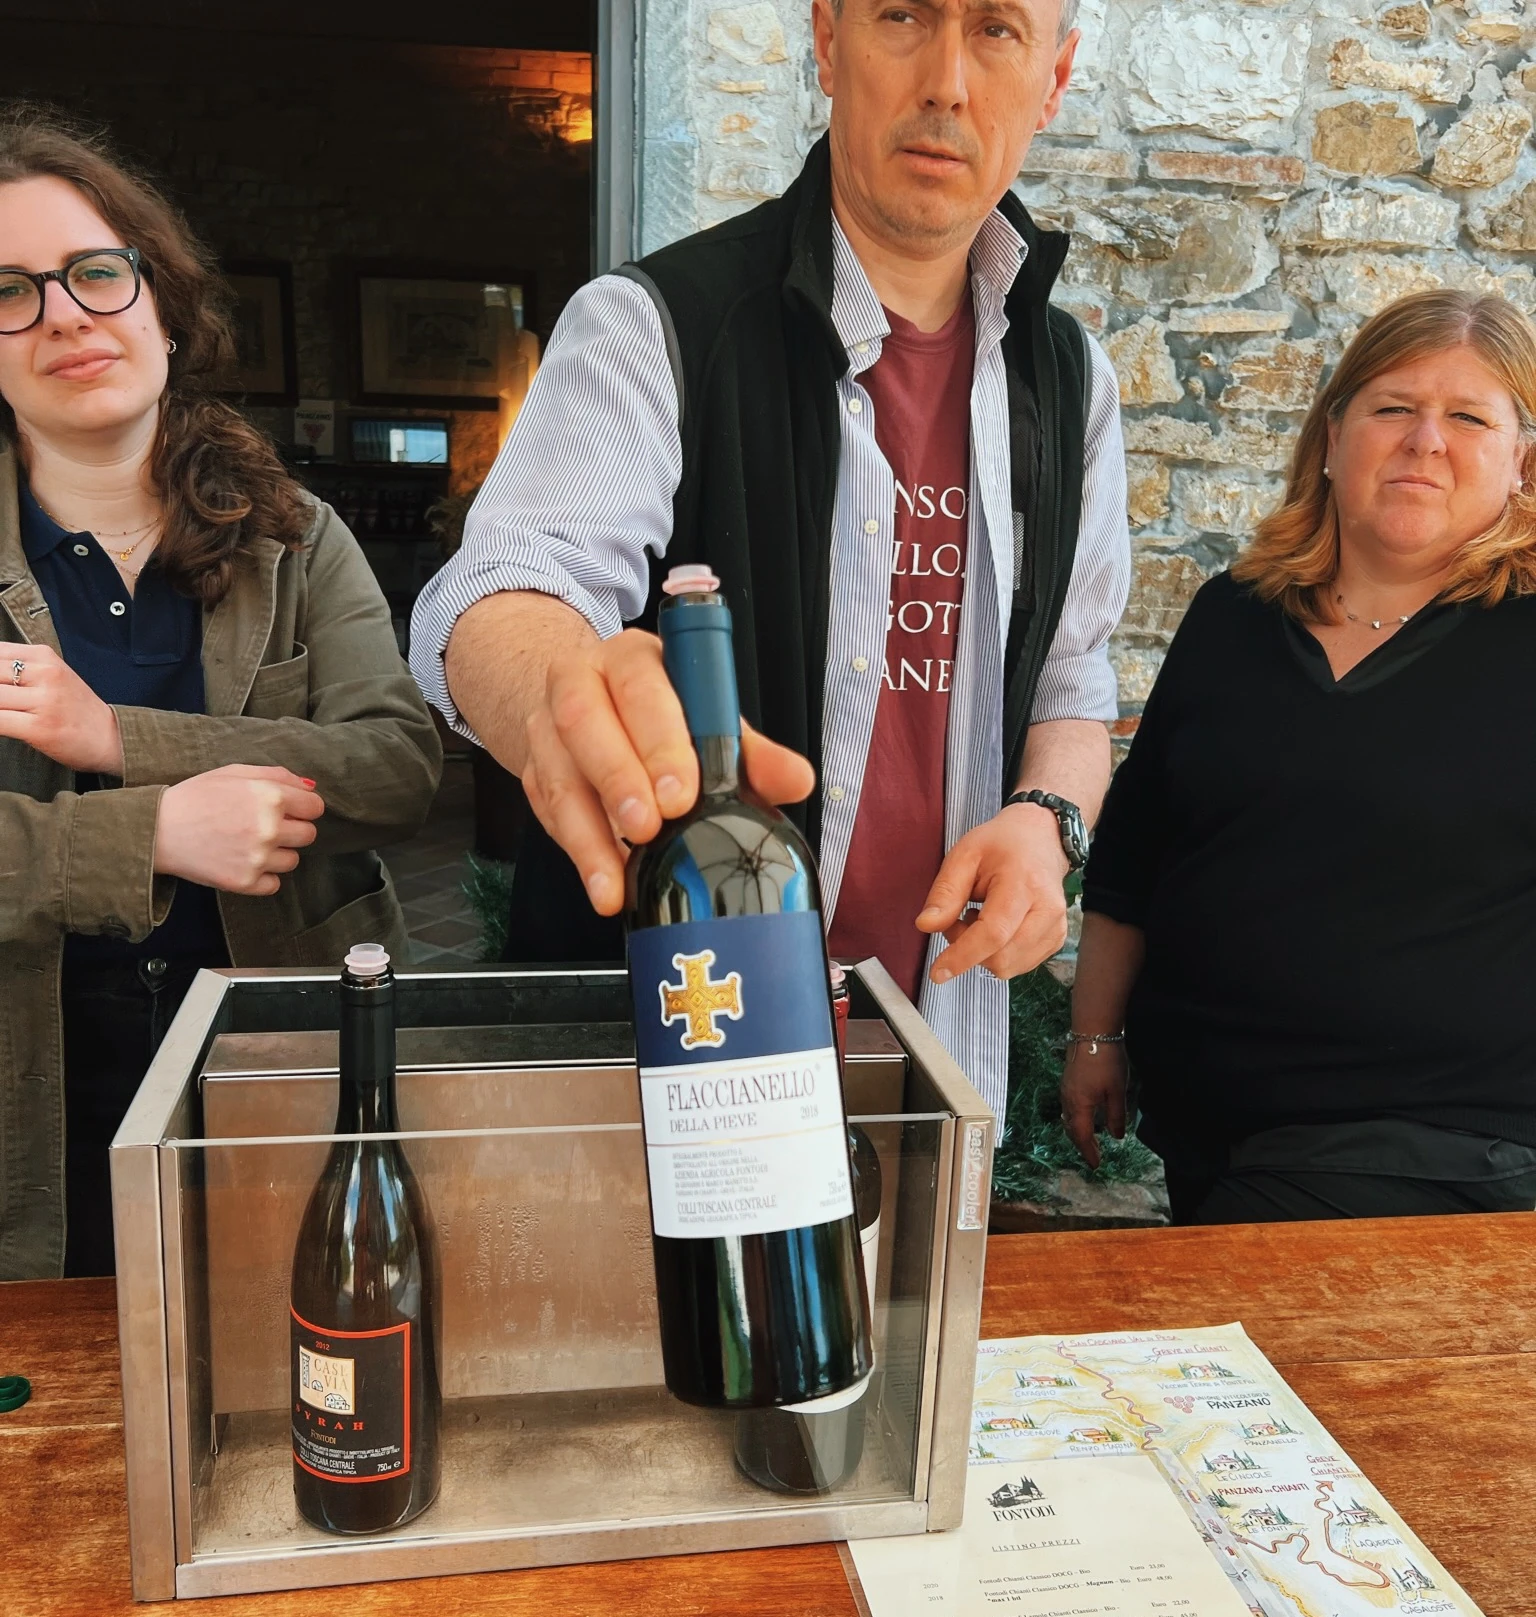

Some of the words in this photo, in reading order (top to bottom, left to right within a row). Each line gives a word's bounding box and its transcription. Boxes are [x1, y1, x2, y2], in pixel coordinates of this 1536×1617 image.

[893, 479, 968, 520] NSO
[880, 657, 953, 692] ANE
[666, 1068, 815, 1111] FLACCIANELLO
[801, 1104, 819, 1120] 2018
[670, 1116, 710, 1133] DELLA
[714, 1112, 757, 1130] PIEVE
[700, 1168, 735, 1178] AGRICOLA
[677, 1201, 697, 1214] COLLI
[697, 1199, 734, 1214] TOSCANA
[734, 1194, 777, 1211] CENTRALE
[315, 1341, 330, 1351] 2012
[1152, 1347, 1183, 1356] GREVE
[1194, 1344, 1229, 1353] CHIANTI
[324, 1374, 348, 1391] VIA
[1206, 1397, 1271, 1410] PANZANO
[295, 1403, 364, 1431] SYRAH
[975, 1410, 996, 1418] PESA
[310, 1428, 337, 1444] FONTODI
[975, 1432, 1010, 1441] TENUTA
[1244, 1438, 1297, 1446] PANZANELLO
[310, 1452, 329, 1466] TOSCANA
[329, 1459, 355, 1470] CENTRALE
[1306, 1454, 1337, 1464] GREVE
[1310, 1466, 1350, 1475] CHIANTI
[1218, 1486, 1262, 1496] PANZANO
[1272, 1483, 1310, 1493] CHIANTI
[992, 1504, 1057, 1522] FONTODI
[992, 1542, 1037, 1552] LISTINO
[1041, 1538, 1081, 1548] PREZZI
[1052, 1570, 1073, 1578] DOCG
[1085, 1579, 1114, 1587] Magnum
